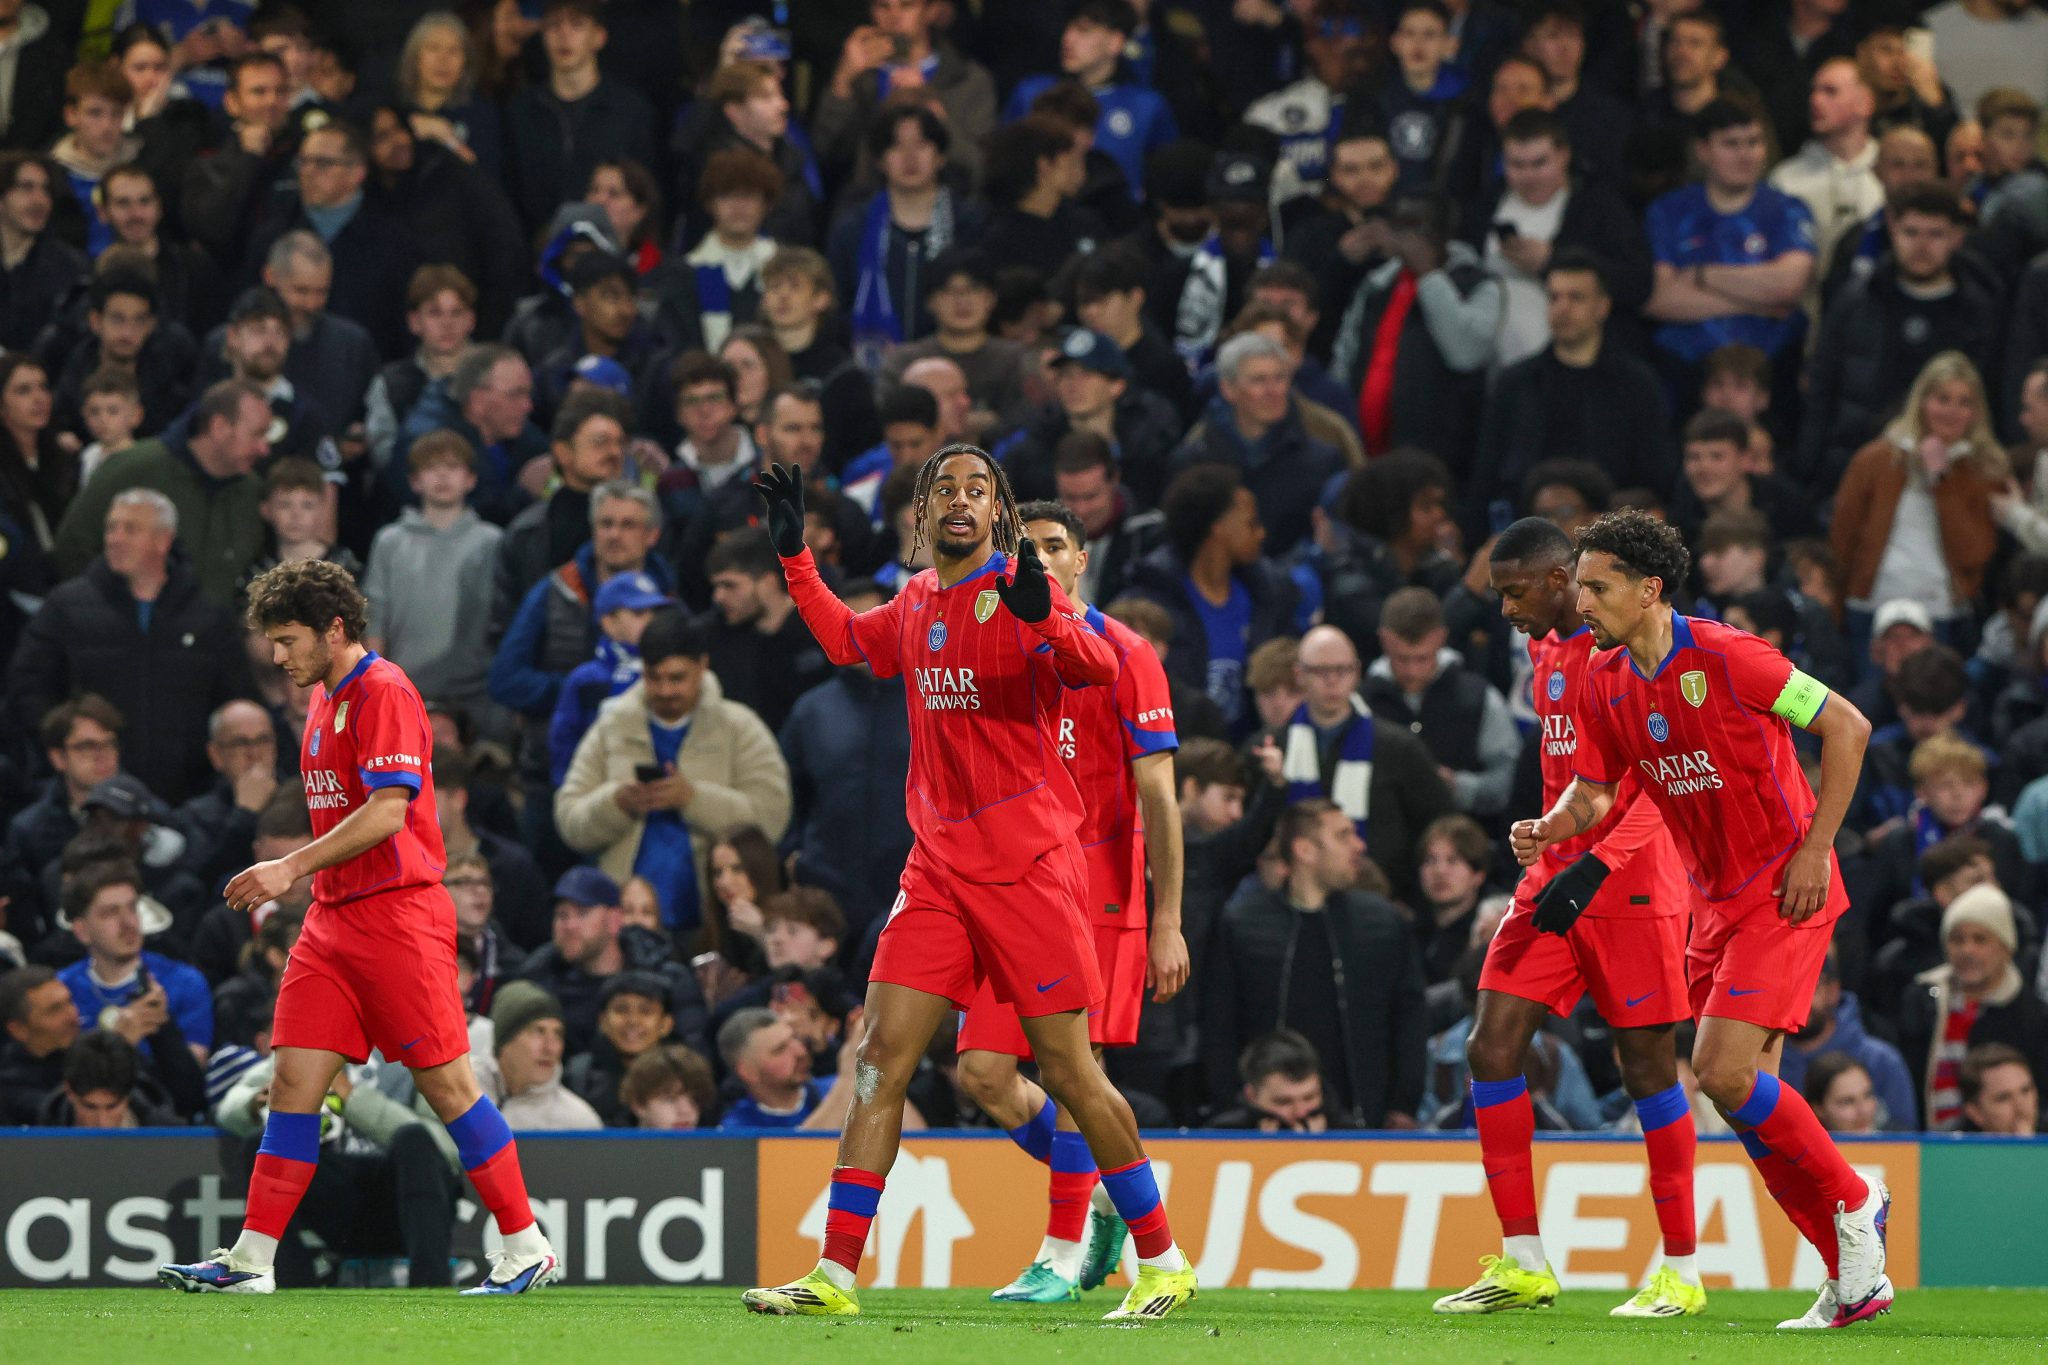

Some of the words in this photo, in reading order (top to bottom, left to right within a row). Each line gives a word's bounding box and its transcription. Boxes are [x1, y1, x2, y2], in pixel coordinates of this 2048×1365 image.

[914, 667, 979, 698] QATAR
[925, 694, 981, 710] AIRWAYS
[1539, 714, 1577, 739] ATA
[367, 753, 421, 770] BEYOND
[1639, 750, 1717, 785] QATAR
[301, 769, 344, 793] ATAR
[1667, 774, 1724, 796] AIRWAYS
[1078, 1160, 1487, 1290] UST
